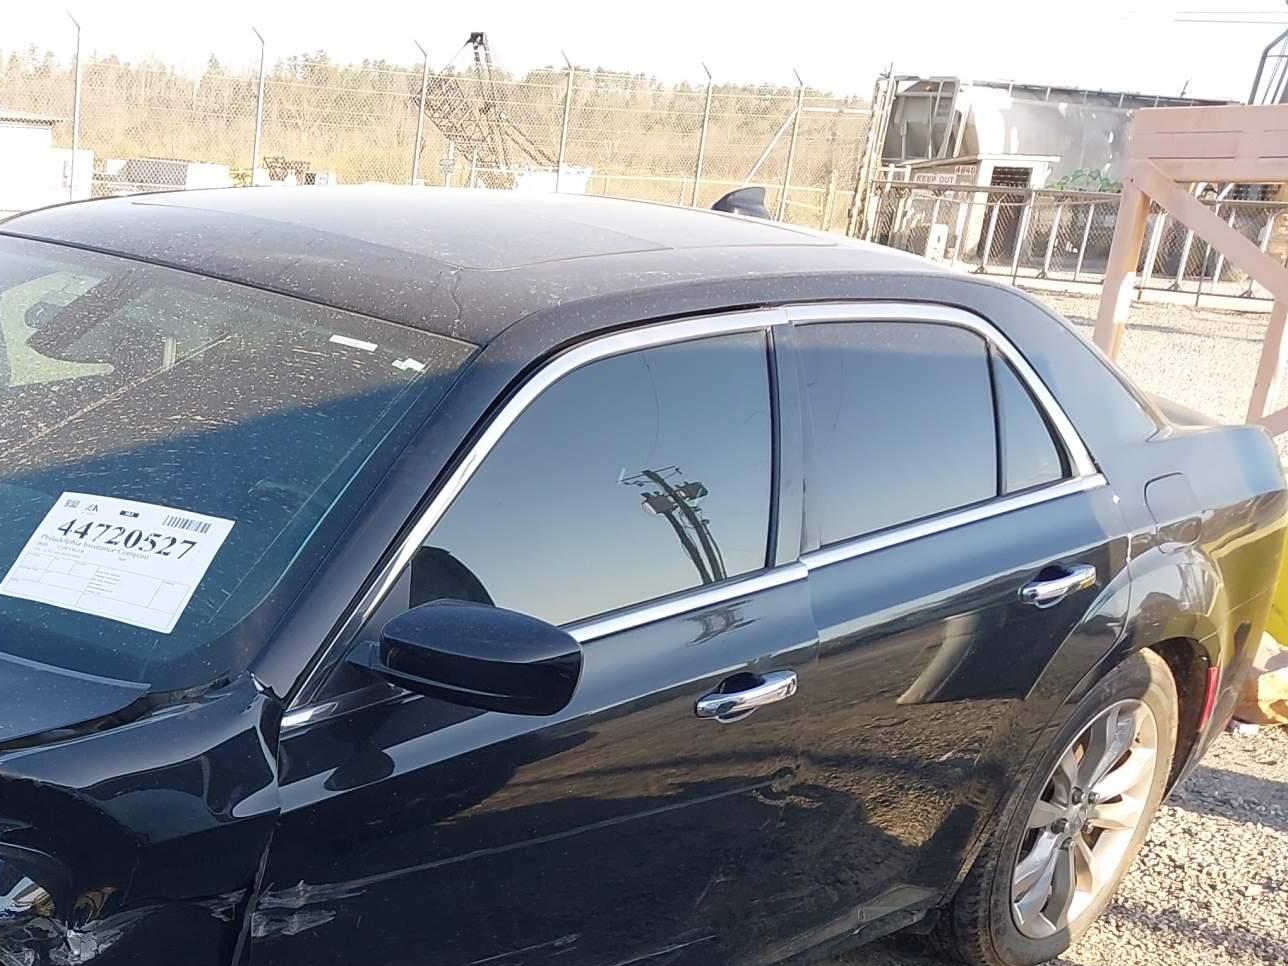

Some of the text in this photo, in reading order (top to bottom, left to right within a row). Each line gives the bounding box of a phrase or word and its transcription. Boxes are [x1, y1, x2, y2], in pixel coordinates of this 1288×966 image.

[916, 175, 954, 184] KEEP OUT
[57, 518, 198, 560] 44720527
